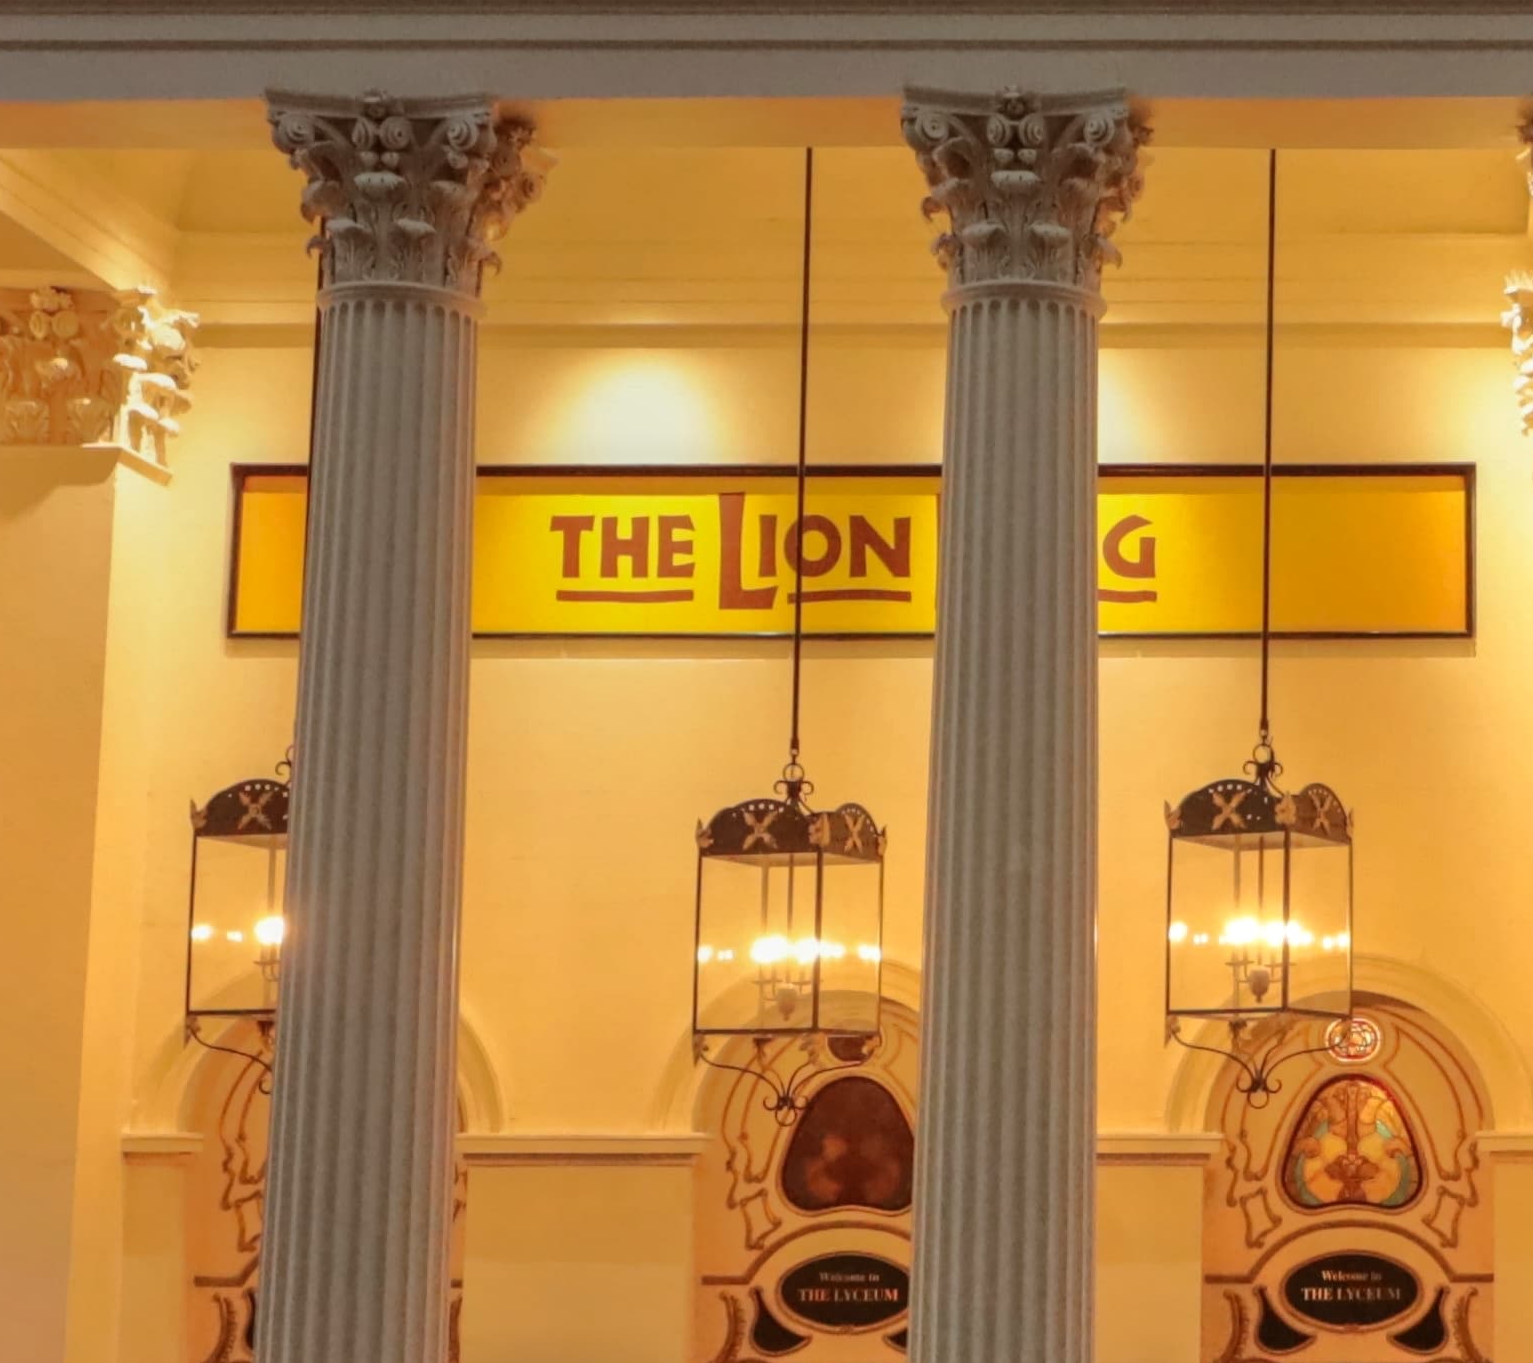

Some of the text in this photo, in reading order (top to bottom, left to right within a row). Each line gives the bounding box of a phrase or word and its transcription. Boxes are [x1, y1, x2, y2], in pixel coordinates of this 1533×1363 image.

[550, 490, 912, 610] THE LION
[1321, 1270, 1368, 1282] Welcome
[799, 1288, 898, 1301] THE LYCEUM
[1301, 1287, 1401, 1301] THE LYCEUM
